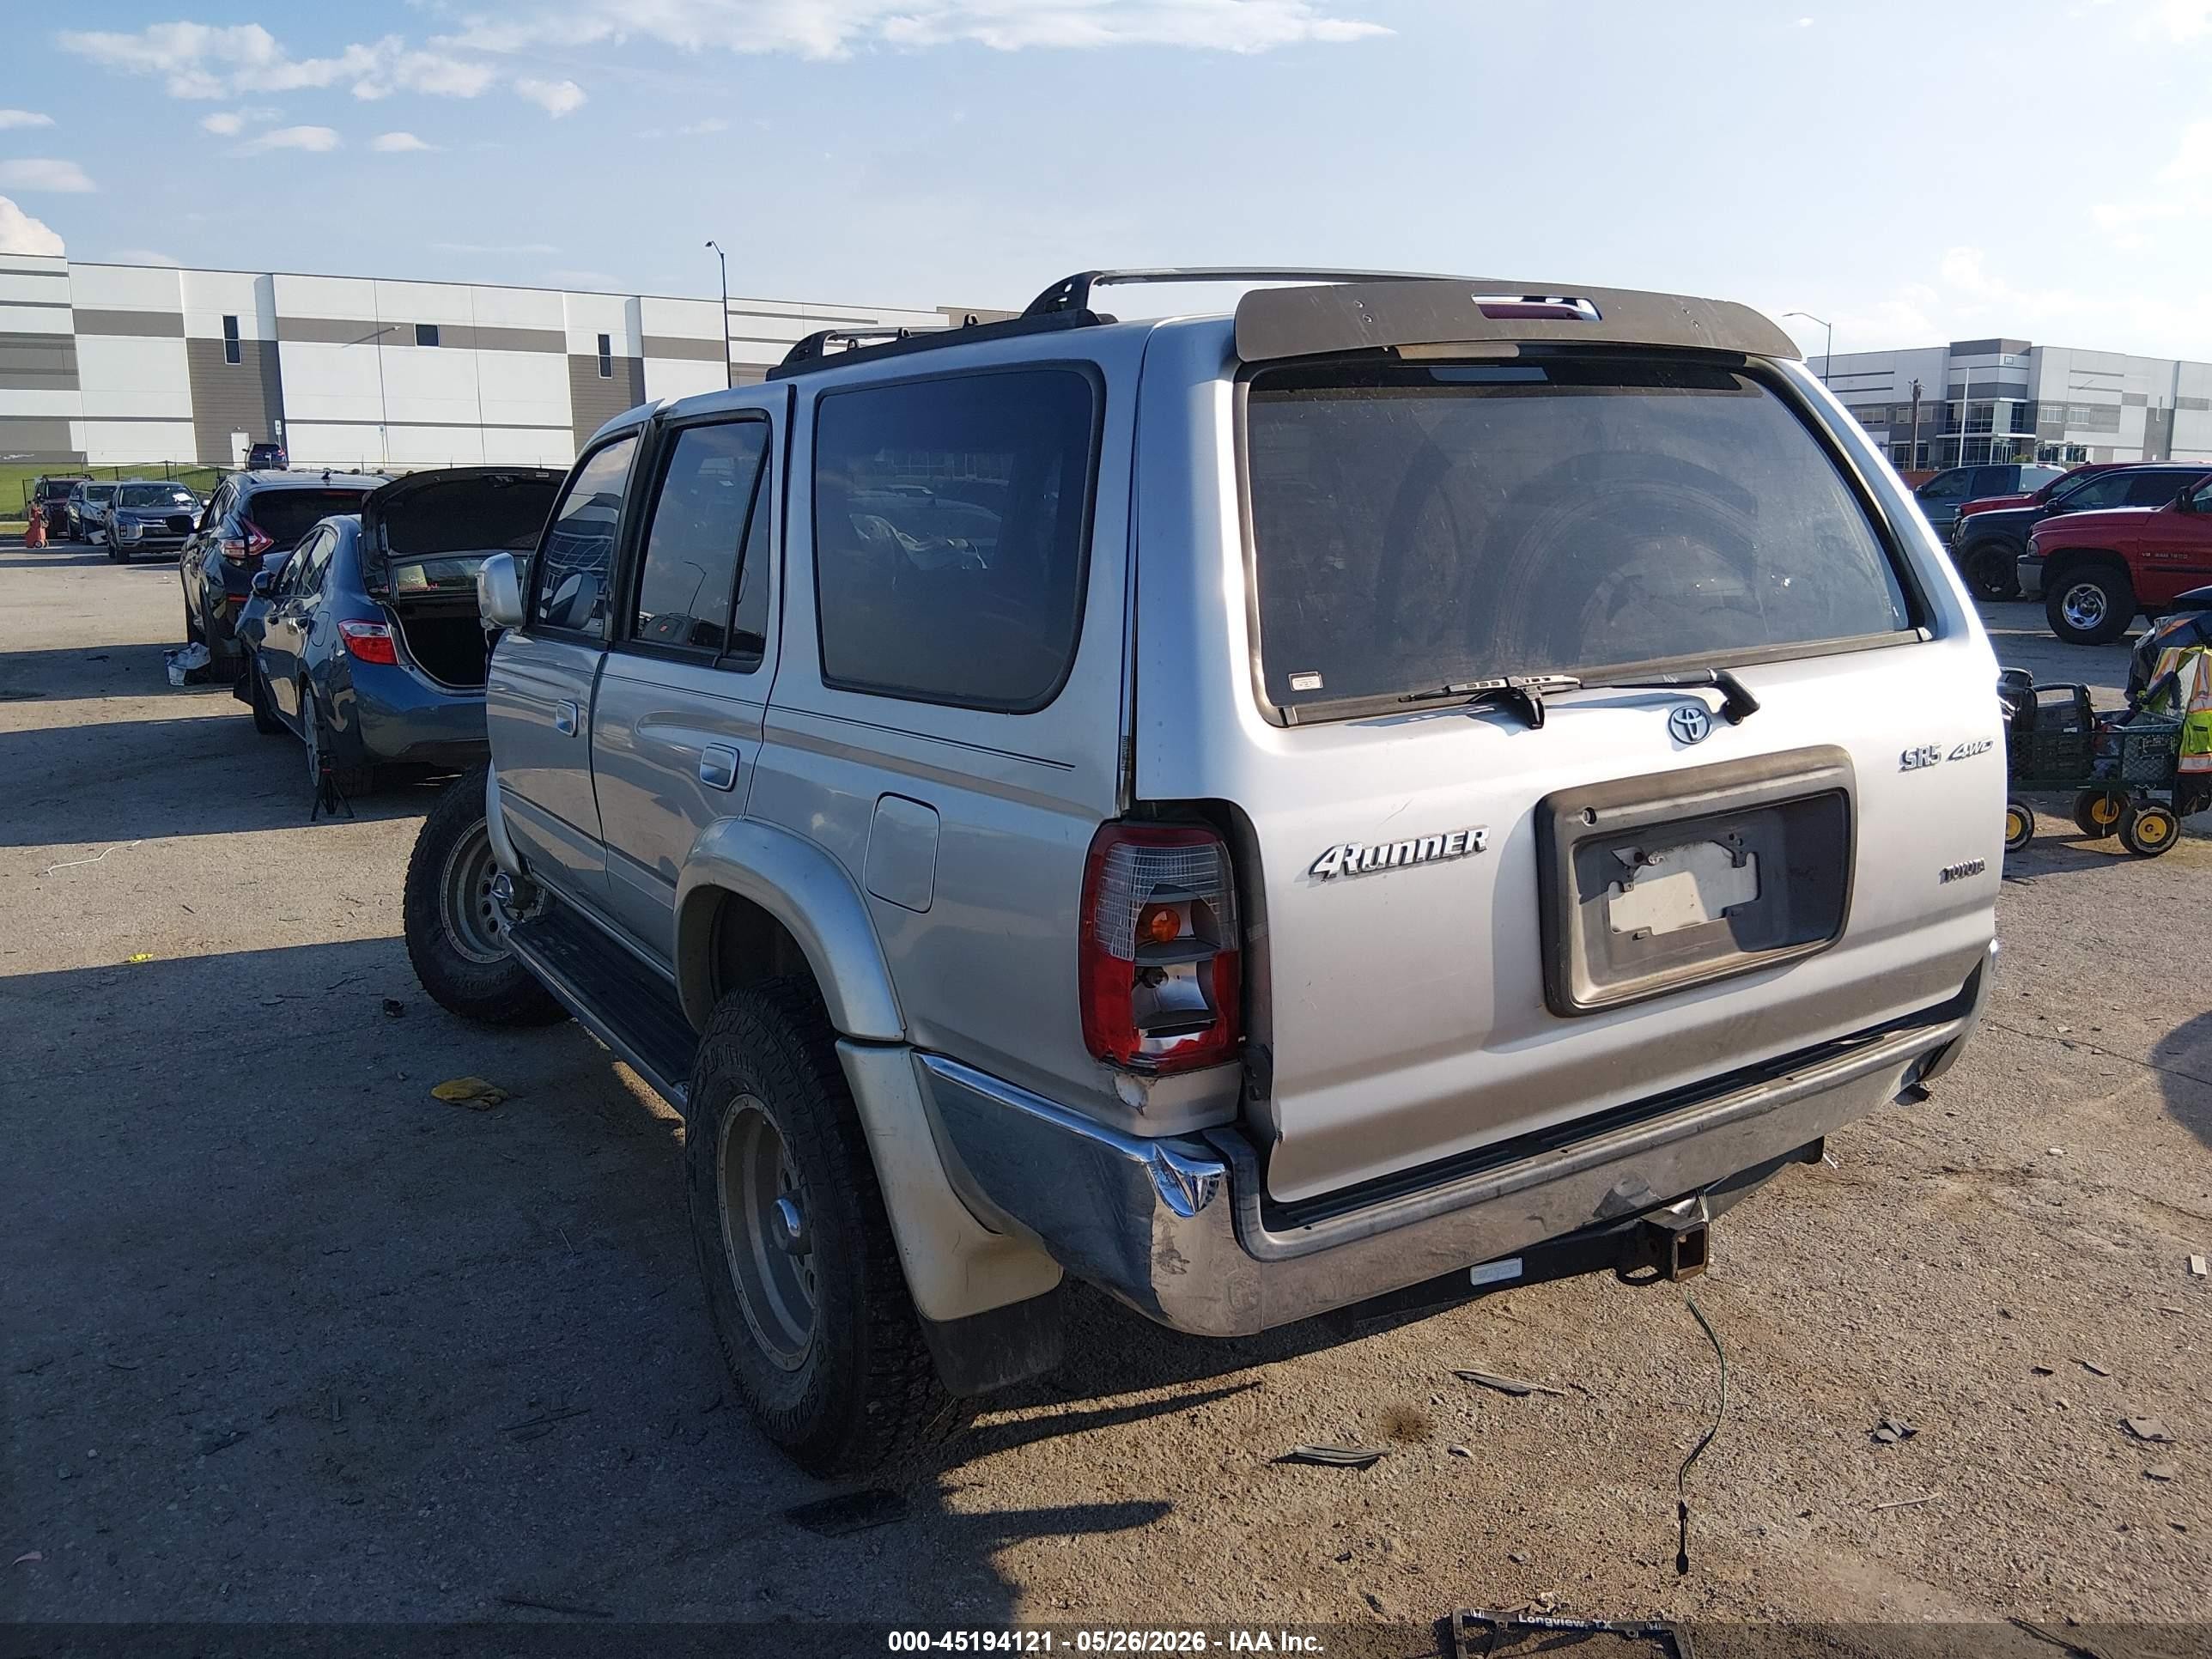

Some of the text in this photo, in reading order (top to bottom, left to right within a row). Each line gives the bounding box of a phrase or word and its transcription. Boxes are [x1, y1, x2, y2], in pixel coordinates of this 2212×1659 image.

[1899, 738, 1994, 773] SR5 4WD
[1518, 1613, 1614, 1631] Longview, TX
